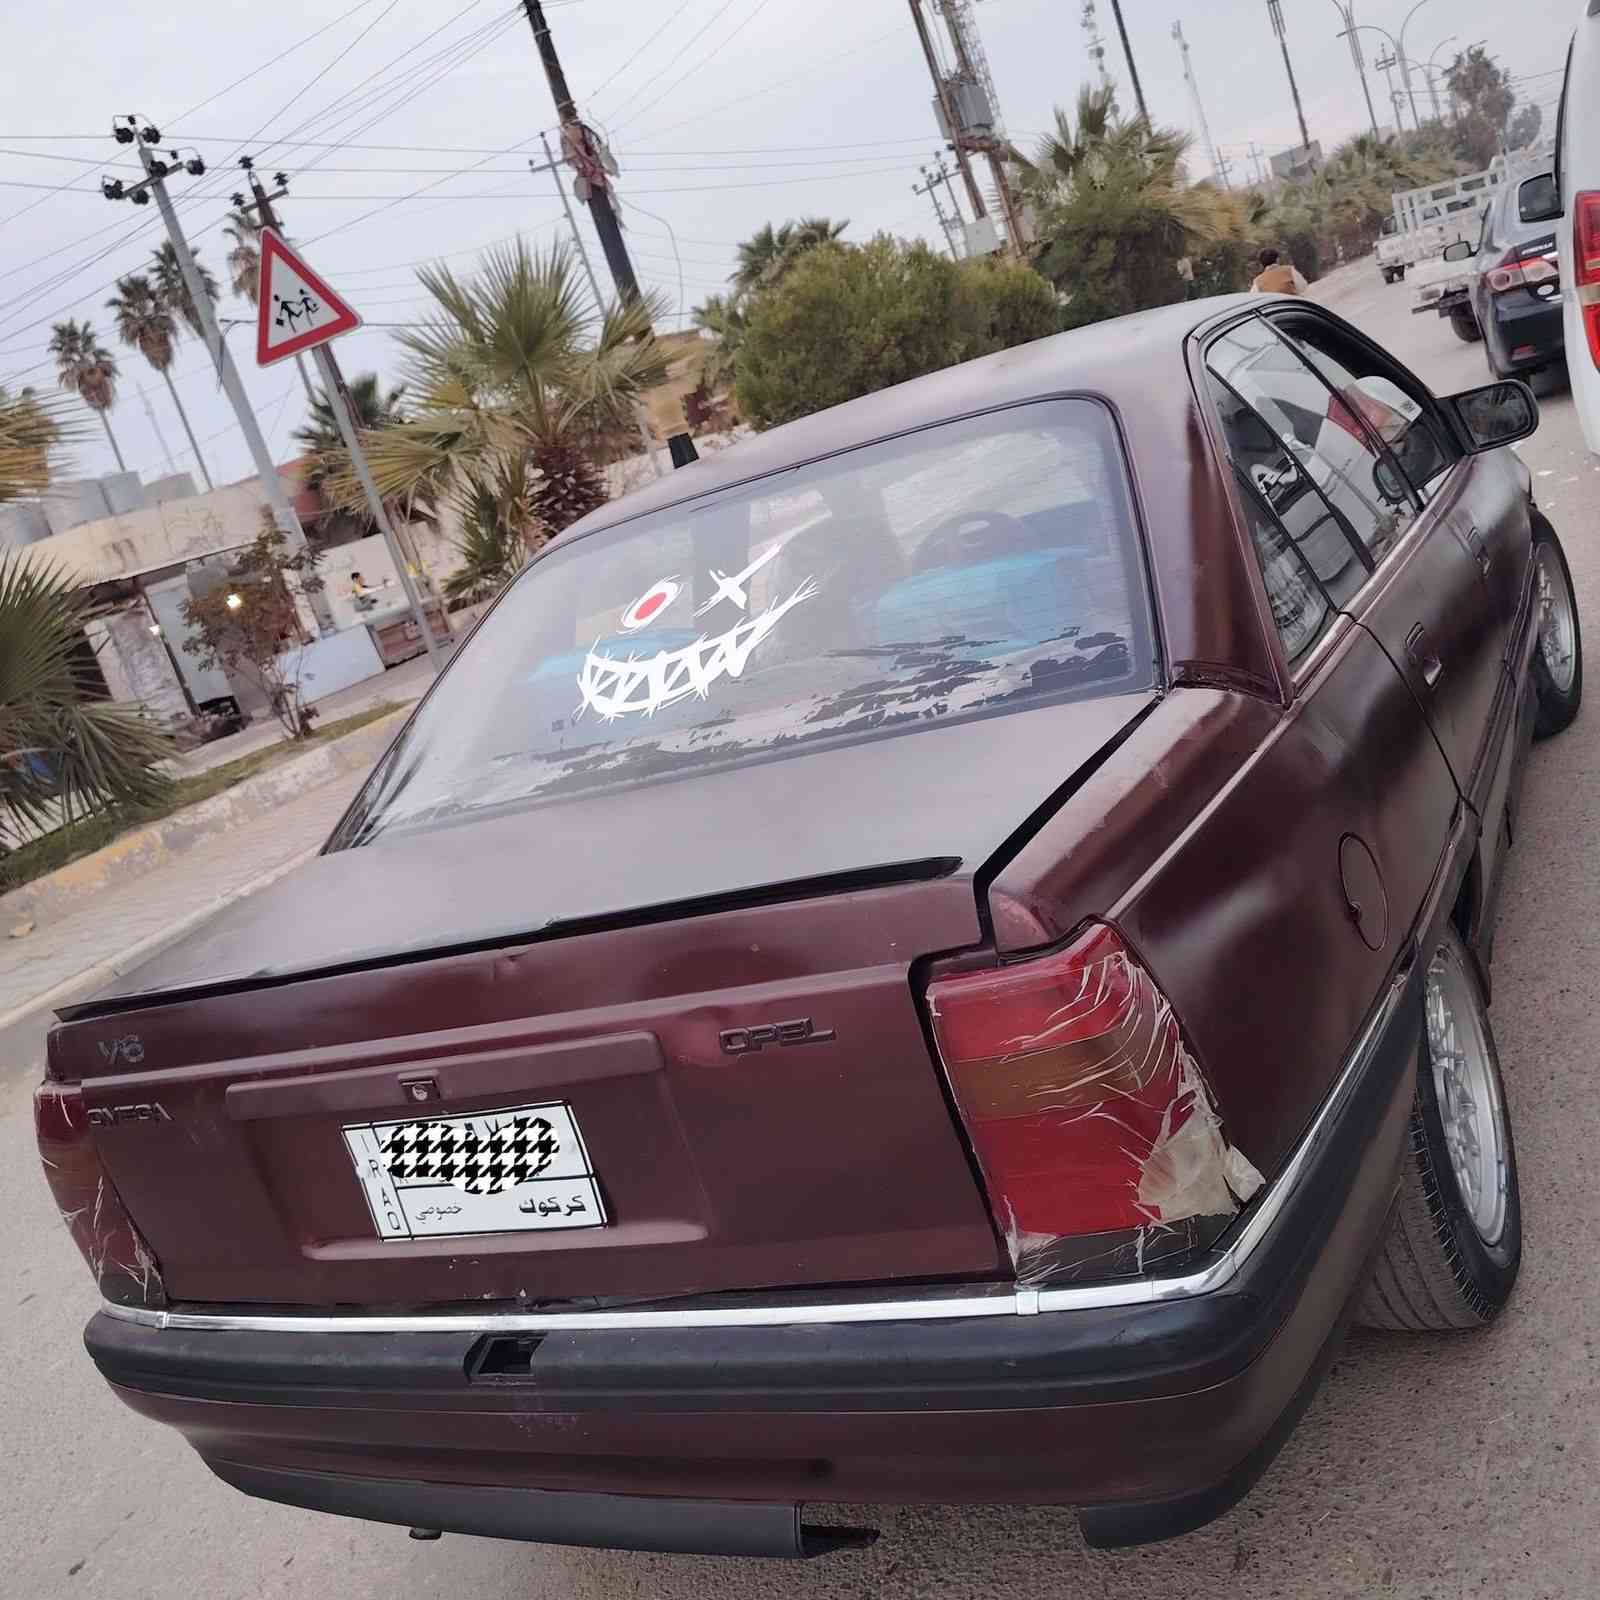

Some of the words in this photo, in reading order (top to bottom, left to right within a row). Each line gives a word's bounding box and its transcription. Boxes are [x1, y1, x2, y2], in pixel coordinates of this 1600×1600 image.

[97, 1033, 144, 1064] V6
[719, 1016, 836, 1055] OPEL
[87, 1101, 174, 1128] OMEGA
[518, 1195, 587, 1217] كركوك
